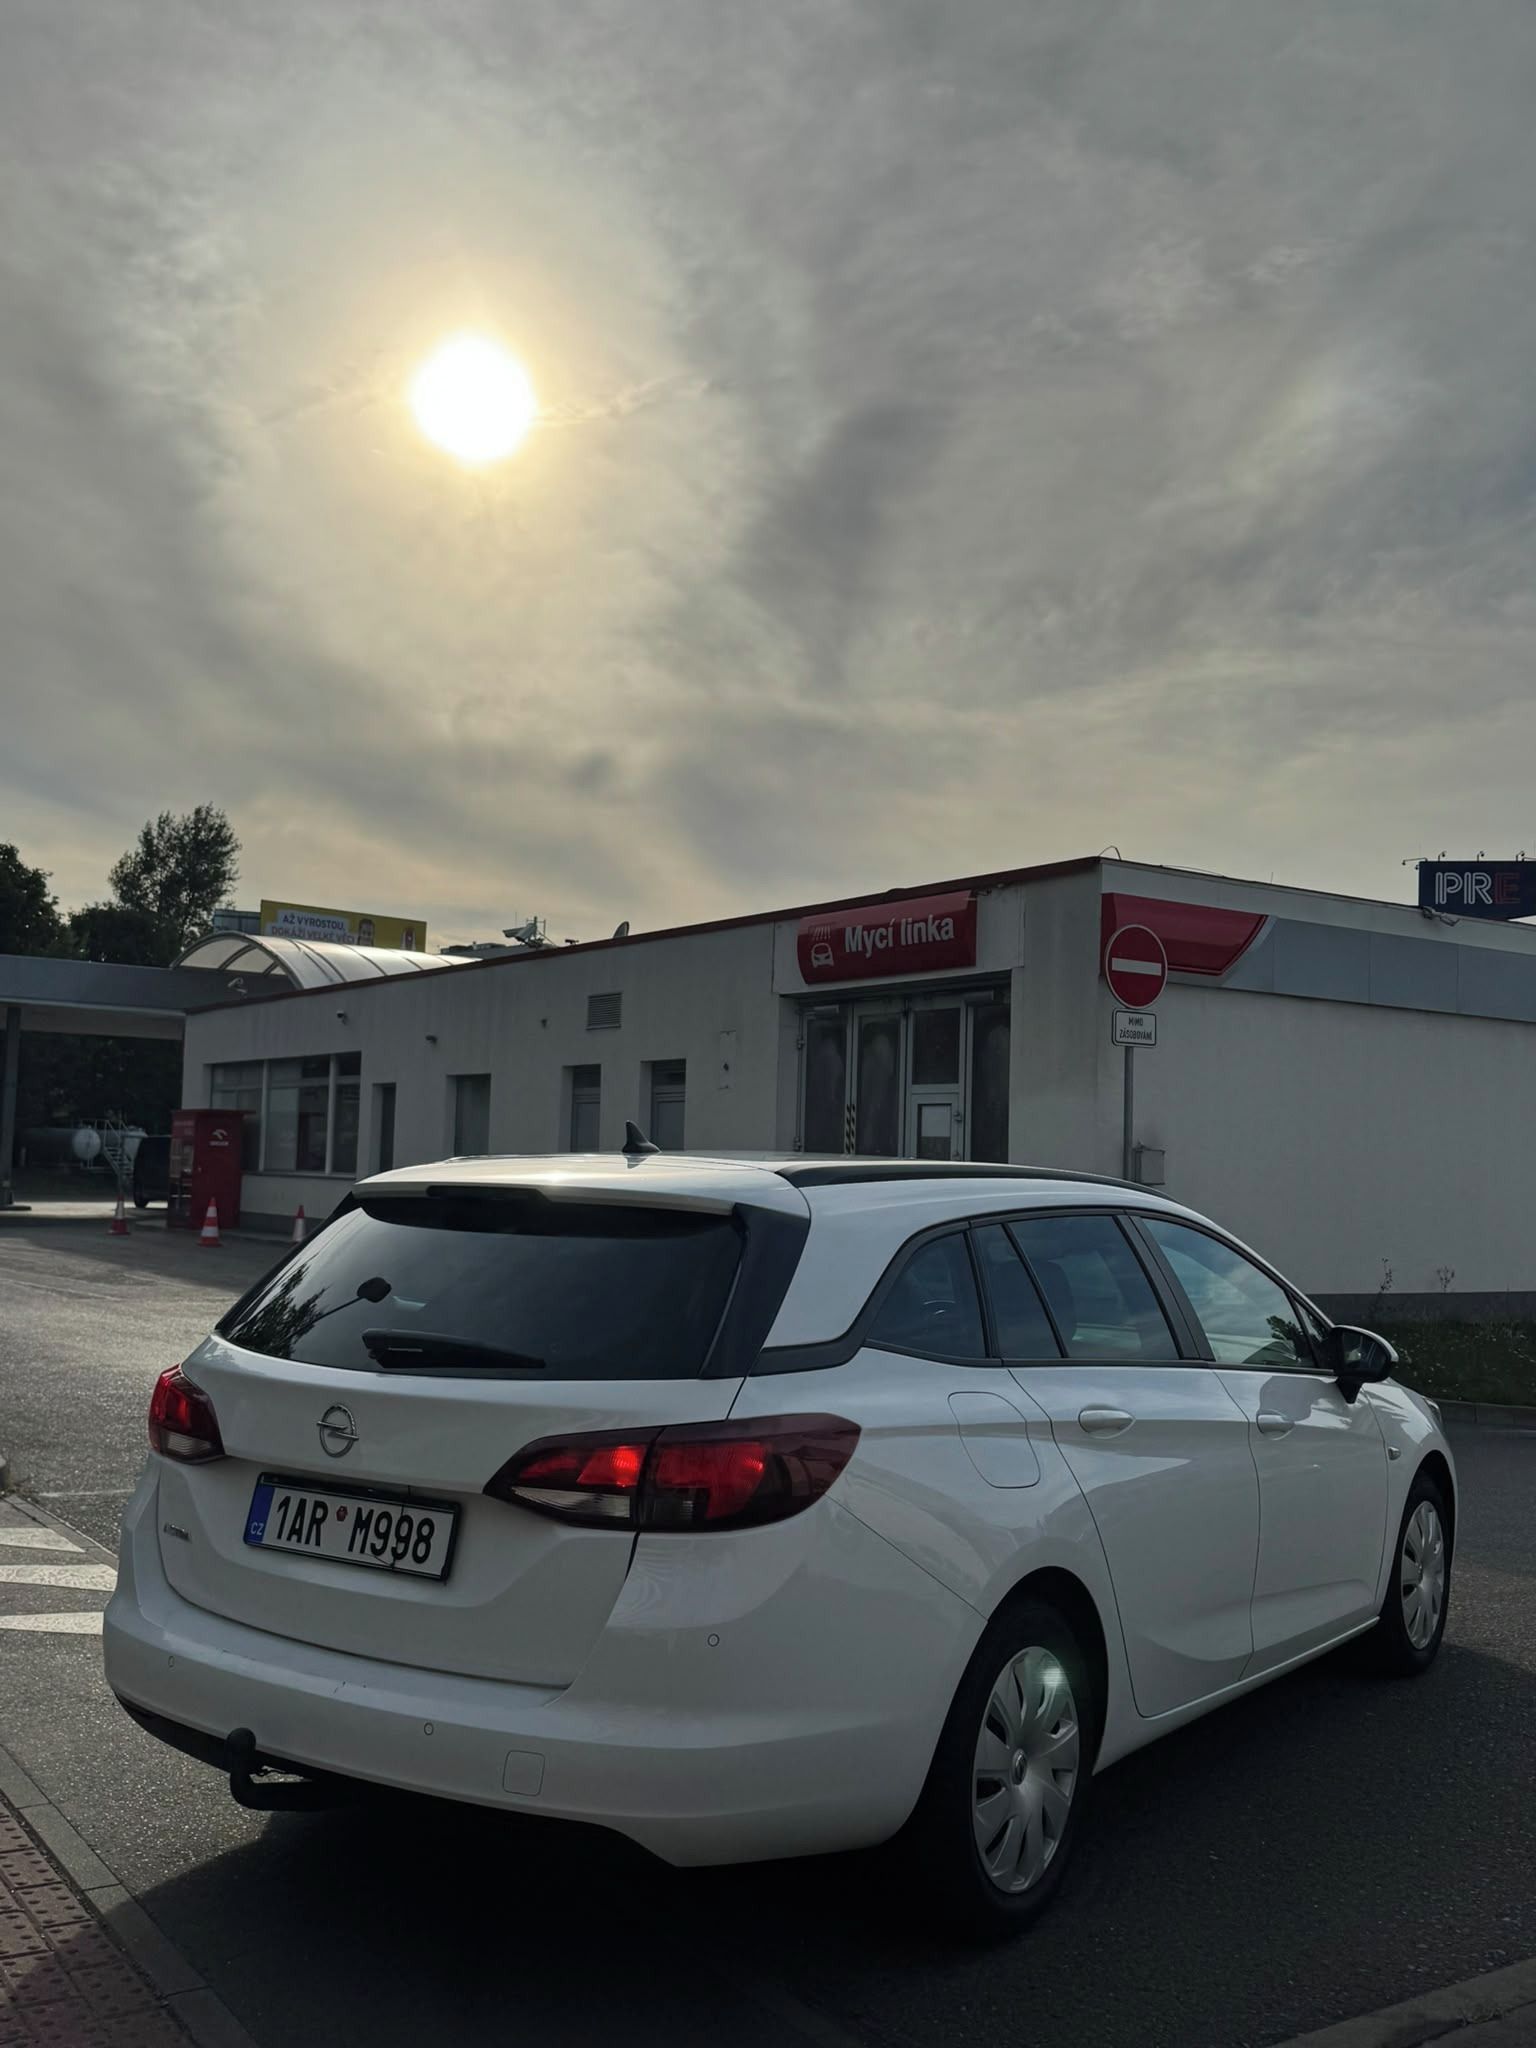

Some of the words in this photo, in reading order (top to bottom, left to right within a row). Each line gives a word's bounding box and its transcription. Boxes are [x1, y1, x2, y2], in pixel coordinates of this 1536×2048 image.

[1435, 872, 1520, 905] PRE
[283, 912, 295, 925] AŽ
[844, 918, 896, 959] Mycí
[900, 914, 955, 946] linka
[1128, 1016, 1144, 1027] MIMO
[250, 1521, 264, 1536] CZ
[276, 1495, 329, 1547] 1AR
[347, 1506, 436, 1564] M998
